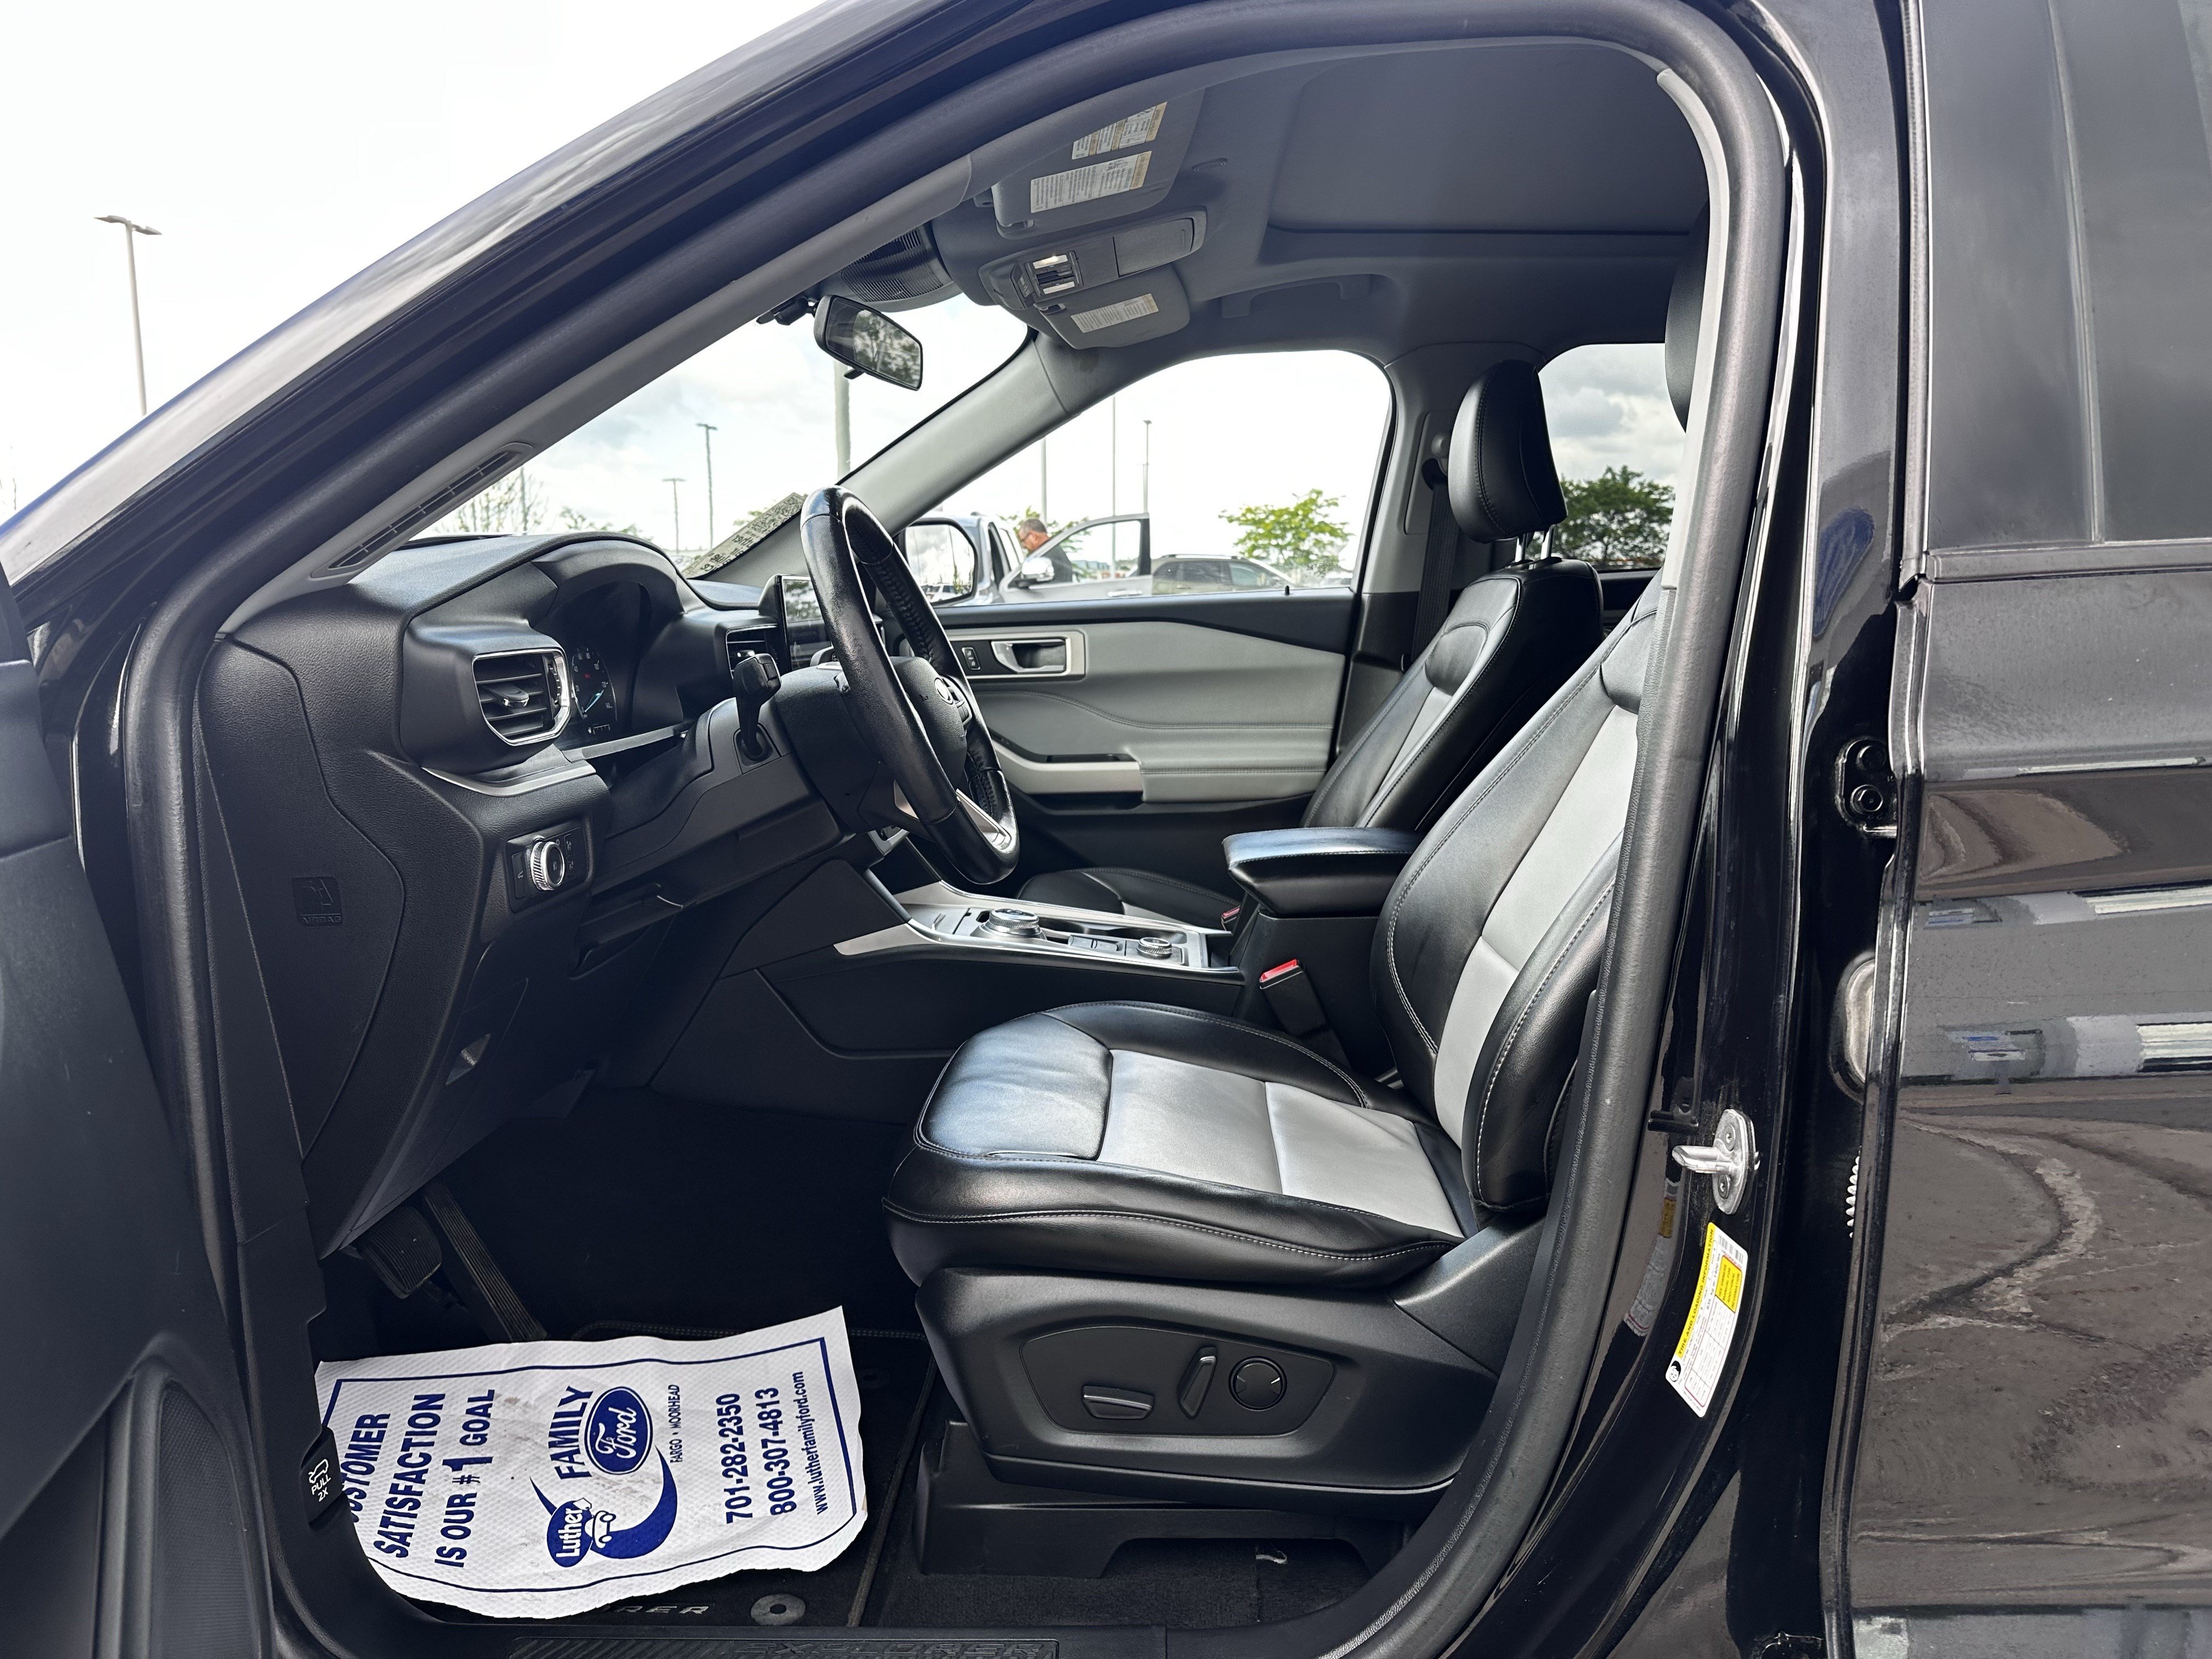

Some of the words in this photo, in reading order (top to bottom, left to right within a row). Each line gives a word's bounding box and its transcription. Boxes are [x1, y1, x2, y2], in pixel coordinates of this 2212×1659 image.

[1678, 1339, 1687, 1355] TIRE
[1692, 1285, 1703, 1318] LOADING
[1702, 1229, 1713, 1283] INFORMATION
[459, 1389, 495, 1446] GOAL
[668, 1384, 681, 1429] MOORHEAD
[548, 1386, 594, 1480] FAMILY
[595, 1407, 637, 1459] Ford
[669, 1438, 683, 1463] FARGO
[715, 1393, 753, 1524] 701-282-2350
[754, 1387, 797, 1516] 800-307-4813
[792, 1372, 828, 1515] www.lutherfamilyford.com
[311, 1474, 331, 1496] PULL
[341, 1413, 391, 1522] STOMER
[373, 1393, 445, 1558] SATISFACTION
[318, 1487, 329, 1502] 2X
[440, 1492, 477, 1541] OUR
[435, 1546, 467, 1568] IS
[556, 1508, 583, 1558] Luther
[735, 1643, 1042, 1656] EXPLORER
